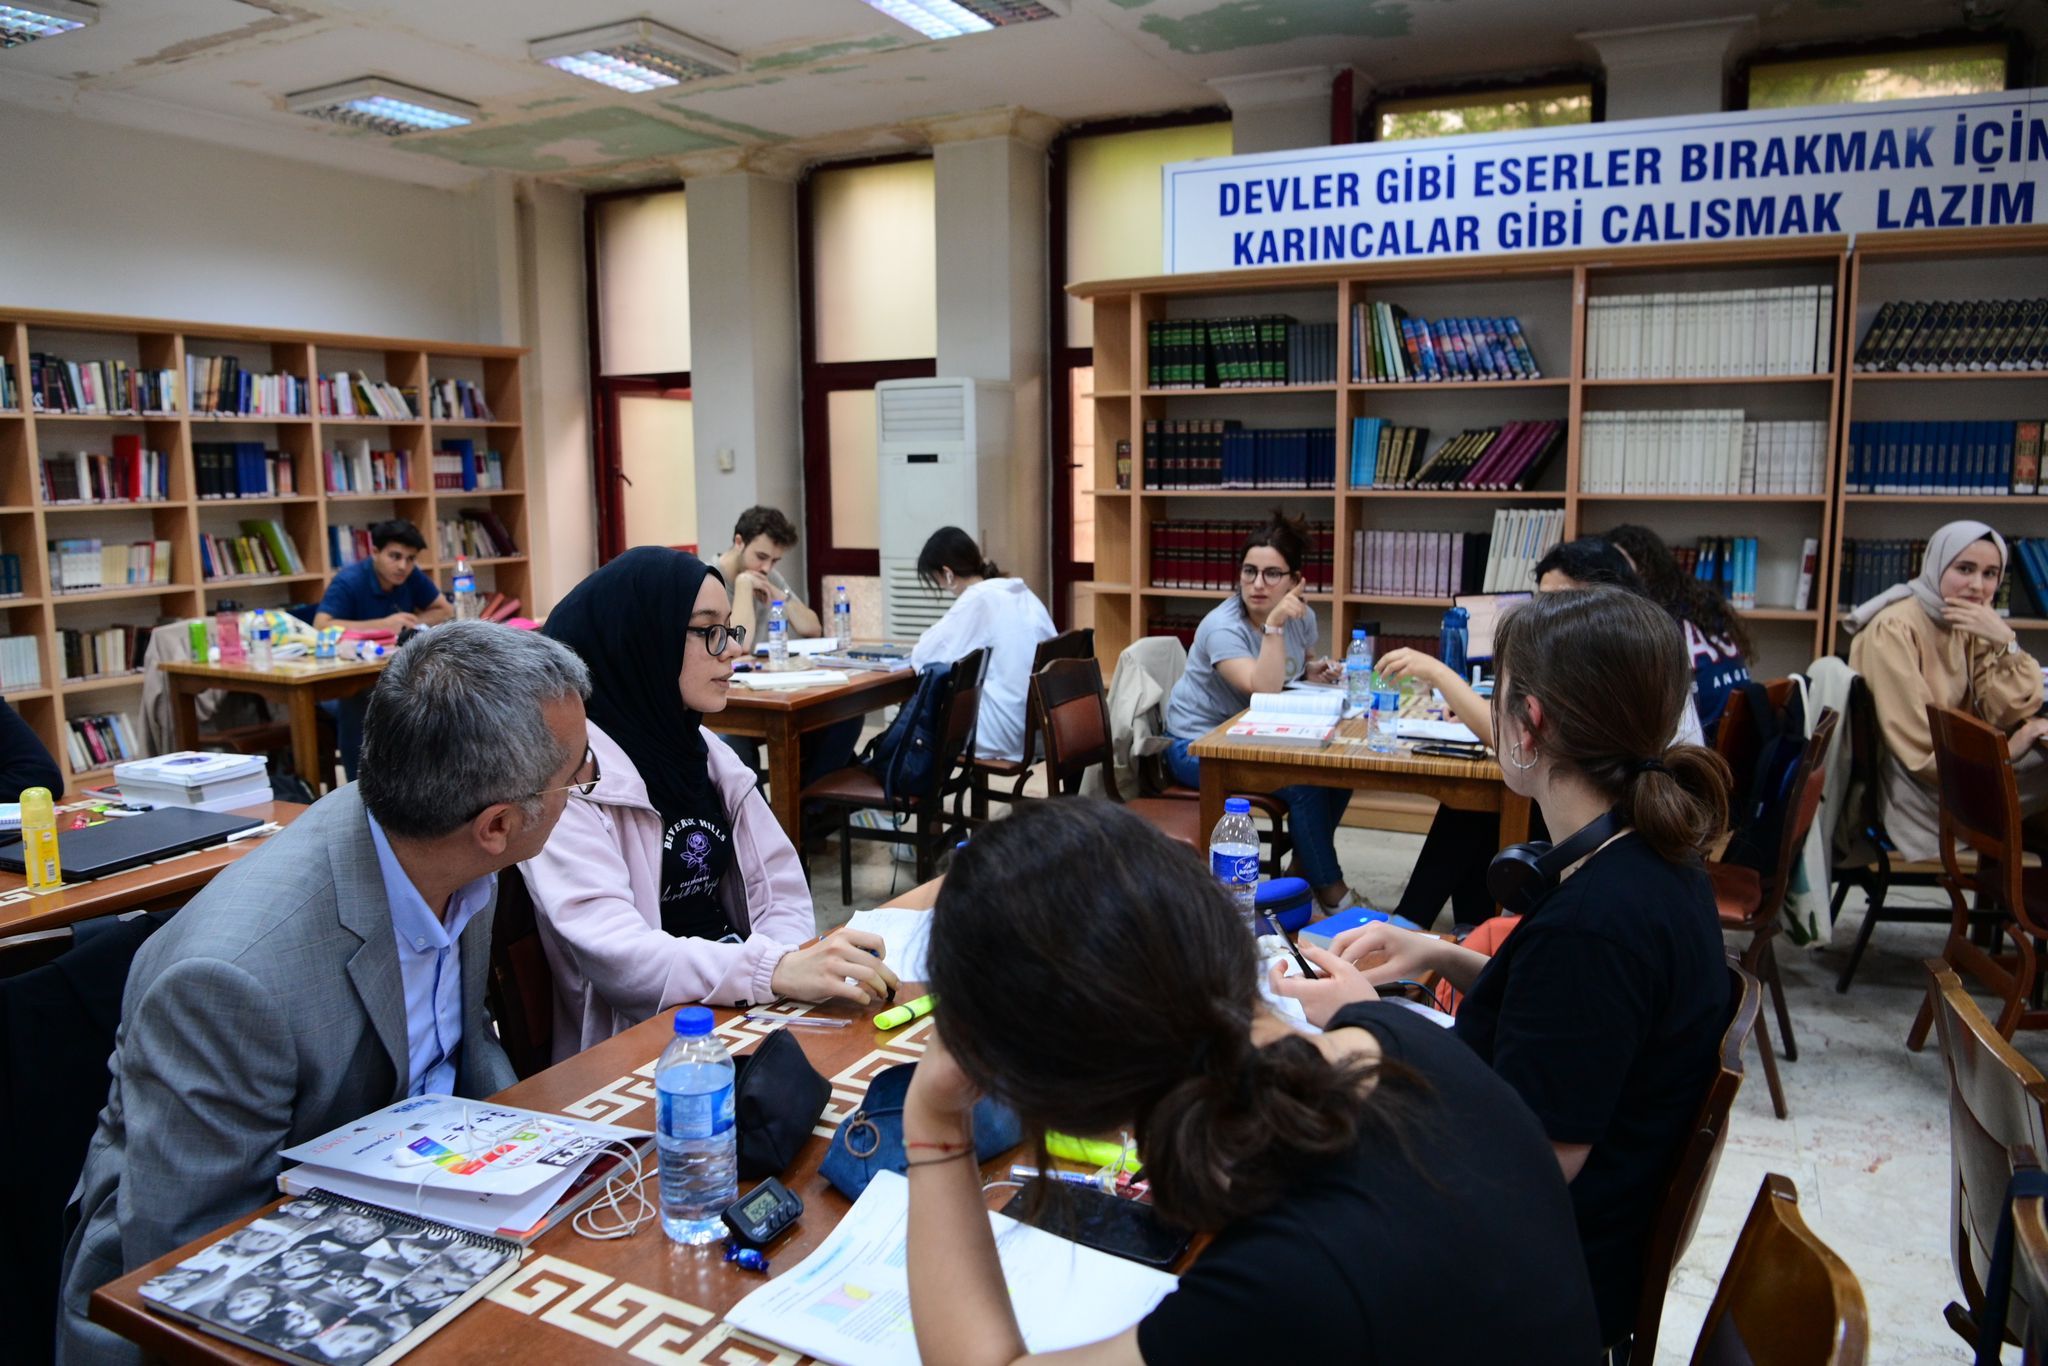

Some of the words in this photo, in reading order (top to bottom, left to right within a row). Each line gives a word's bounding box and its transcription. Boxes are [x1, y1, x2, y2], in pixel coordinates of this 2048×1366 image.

[1219, 172, 1360, 217] DEVLER
[1376, 154, 1456, 205] GİBİ
[1473, 147, 1662, 198] ESERLER
[1680, 125, 1936, 184] BIRAKMAK
[1953, 109, 2048, 173] İÇİN
[1233, 215, 1480, 266] KARINCALAR
[1498, 199, 1583, 250] GİBİ
[1601, 191, 1844, 245] CALISMAK
[1876, 181, 2036, 230] LAZIM
